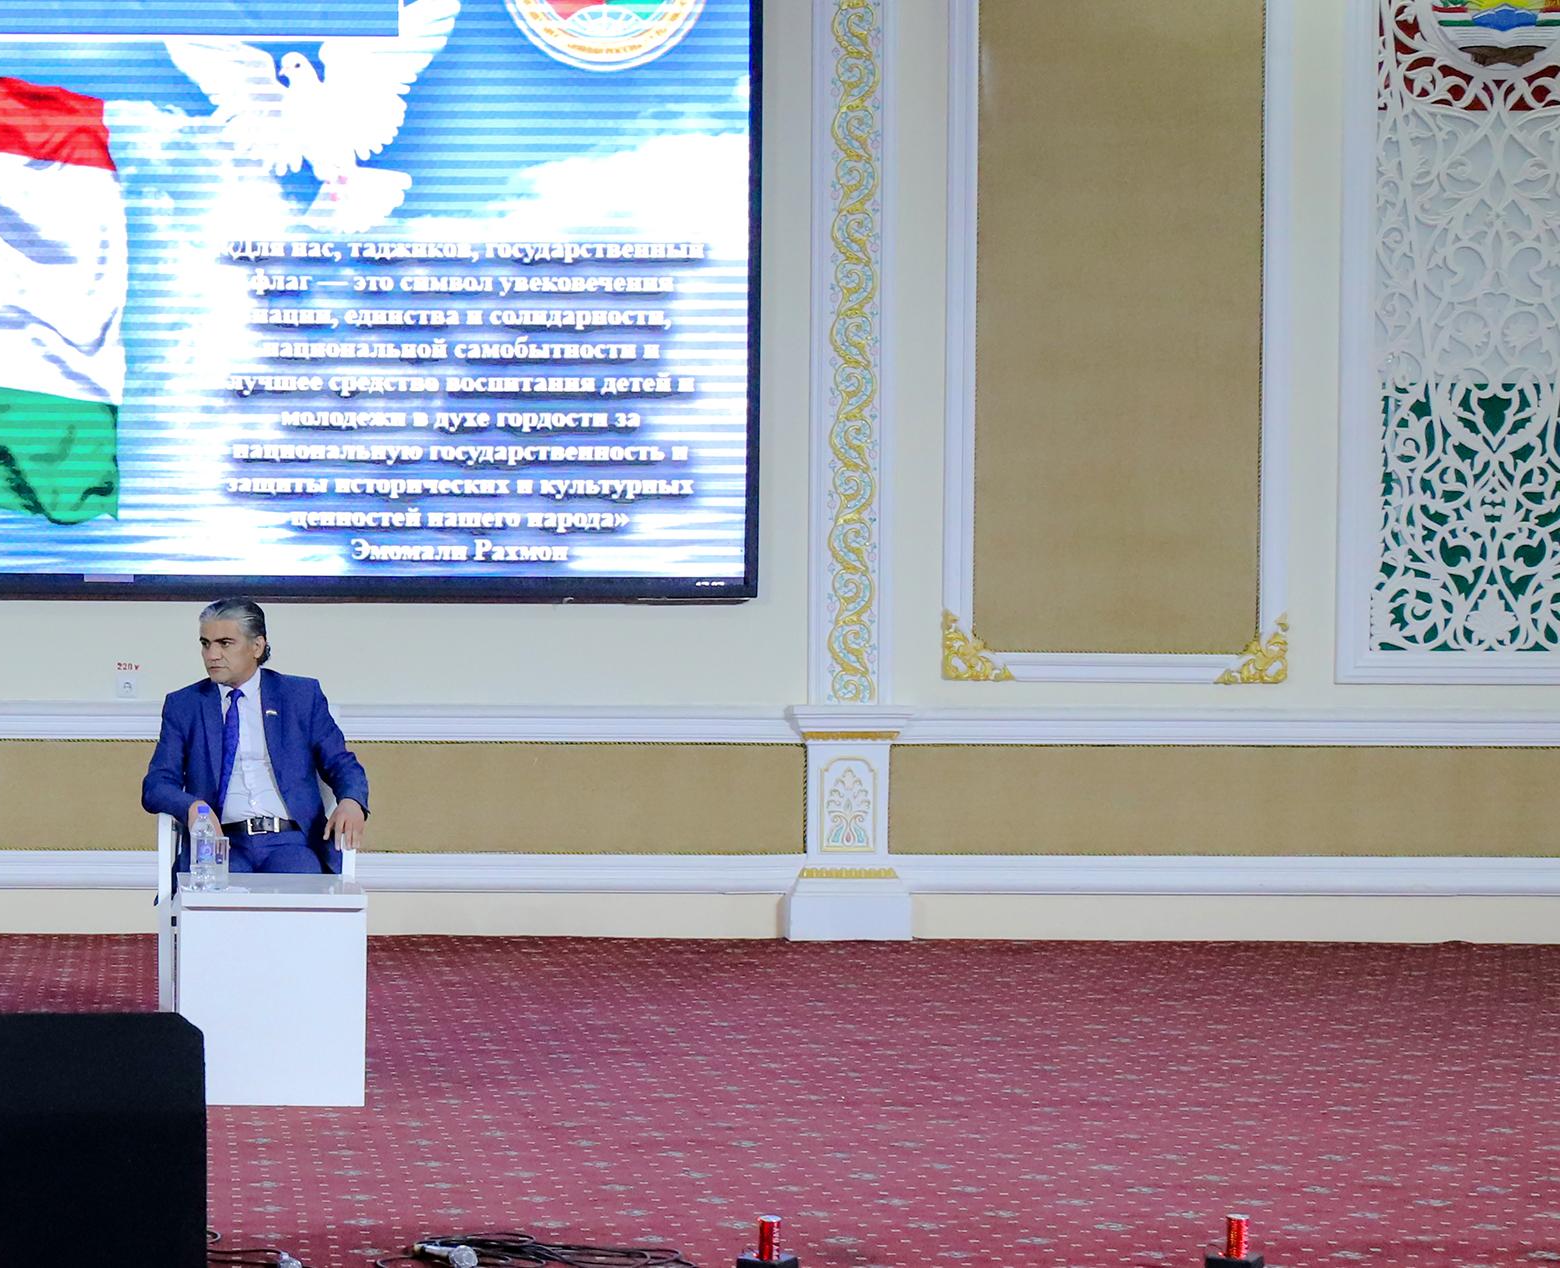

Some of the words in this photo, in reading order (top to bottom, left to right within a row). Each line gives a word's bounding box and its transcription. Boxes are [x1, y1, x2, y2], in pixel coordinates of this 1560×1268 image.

[291, 242, 342, 262] нас,
[348, 242, 480, 262] таджиков,
[248, 268, 312, 295] флаг
[353, 275, 394, 292] это
[400, 276, 494, 292] символ
[498, 276, 674, 297] увековечения
[251, 308, 339, 329] нации,
[344, 309, 460, 328] единства
[466, 310, 484, 325] и
[489, 310, 672, 330] солидарности,
[261, 337, 448, 360] национальной
[453, 335, 637, 359] самобытности
[643, 343, 660, 359] и
[225, 375, 324, 396] лучшее
[328, 376, 440, 396] средство
[445, 377, 596, 393] воспитания
[600, 372, 672, 395] детей
[677, 377, 696, 393] и
[280, 411, 407, 429] молодежи
[412, 412, 429, 427] в
[433, 412, 490, 433] духе
[496, 412, 609, 433] гордости
[615, 412, 640, 428] за
[232, 444, 424, 465] национальную
[429, 445, 666, 466] государственность
[671, 446, 689, 461] и
[225, 477, 328, 496] защиты
[334, 478, 511, 499] исторических
[516, 479, 534, 494] и
[539, 479, 695, 500] культурных
[290, 507, 423, 530] ценностей
[427, 511, 522, 528] нашего
[526, 511, 631, 533] народа»
[350, 538, 469, 561] Эмомали
[473, 538, 570, 561] Рахмон
